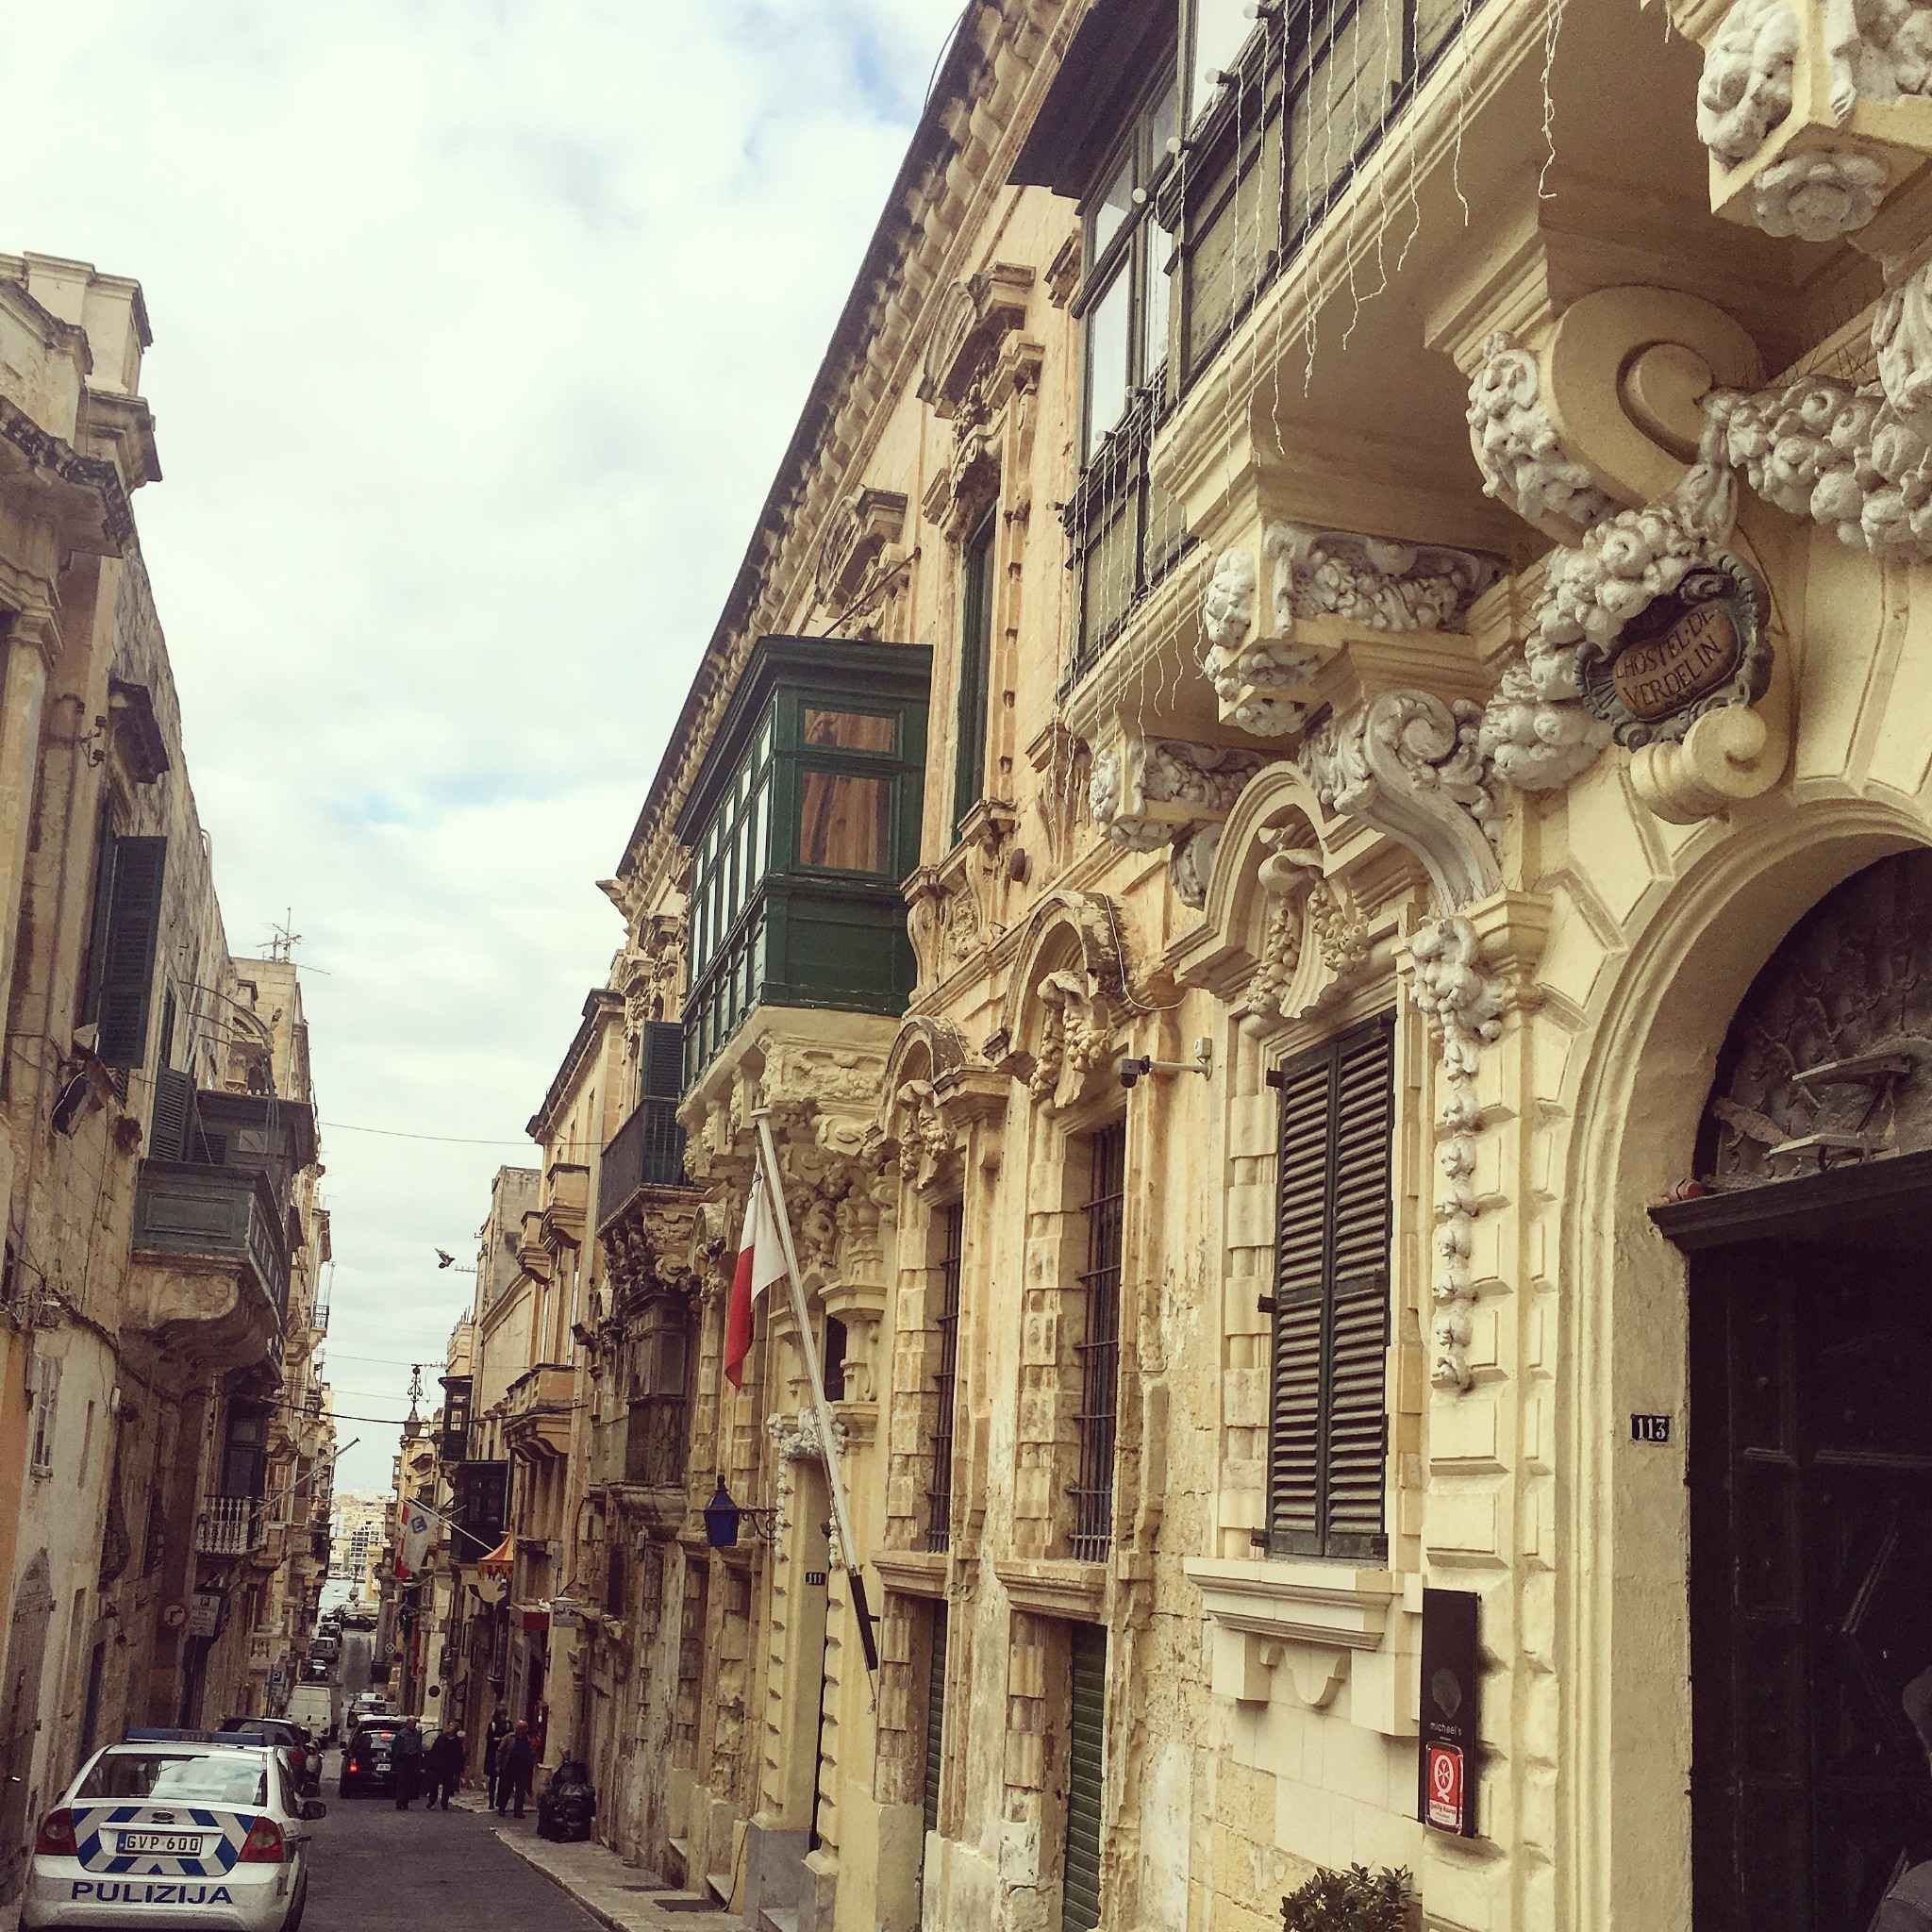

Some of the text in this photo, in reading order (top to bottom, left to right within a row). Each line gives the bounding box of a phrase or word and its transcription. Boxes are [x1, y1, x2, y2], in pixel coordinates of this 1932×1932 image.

[1622, 634, 1722, 710] VERDELIN
[1637, 1417, 1667, 1440] 113
[125, 1835, 199, 1852] GVP 600
[71, 1881, 234, 1905] PULIZIJA
